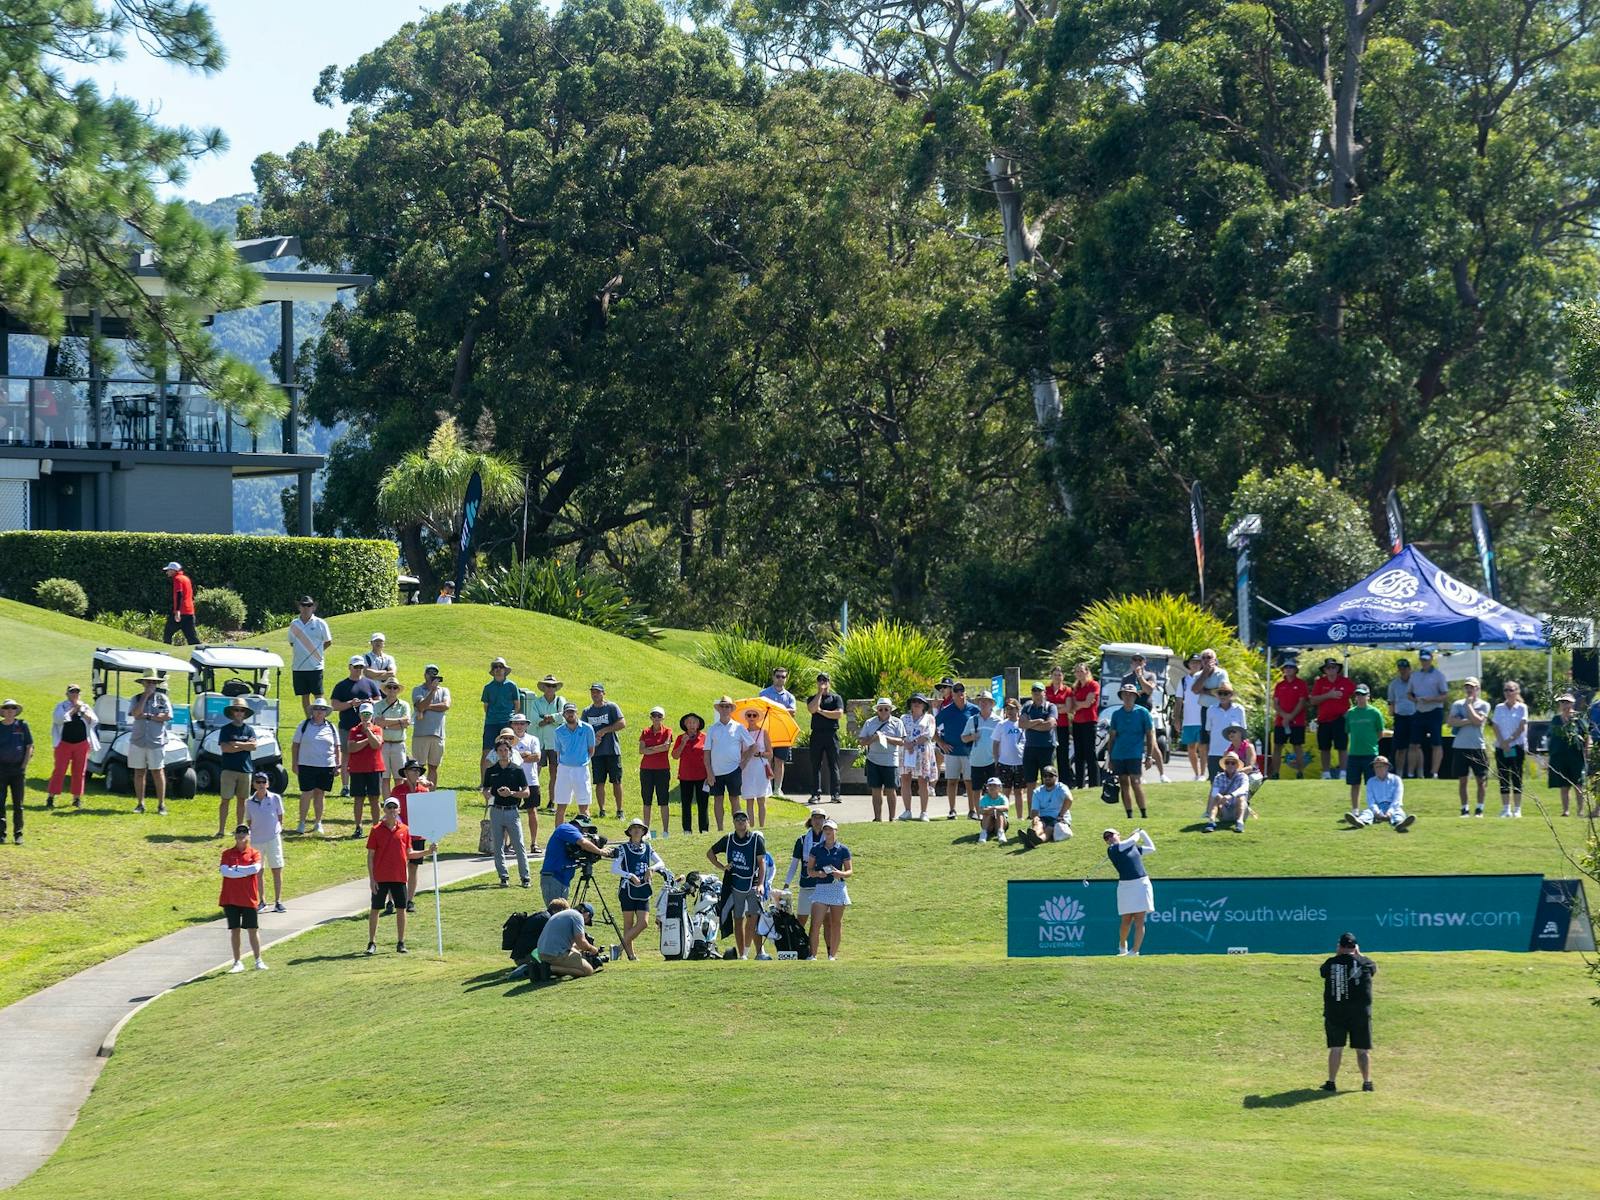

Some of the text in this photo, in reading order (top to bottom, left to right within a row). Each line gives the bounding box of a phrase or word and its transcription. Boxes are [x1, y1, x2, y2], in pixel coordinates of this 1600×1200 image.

[1349, 622, 1416, 631] COFFSCOAST
[1180, 910, 1220, 922] new
[1224, 906, 1273, 922] south
[1277, 905, 1327, 921] wales
[1376, 908, 1520, 927] visitnsw.com
[1039, 925, 1085, 941] NSW
